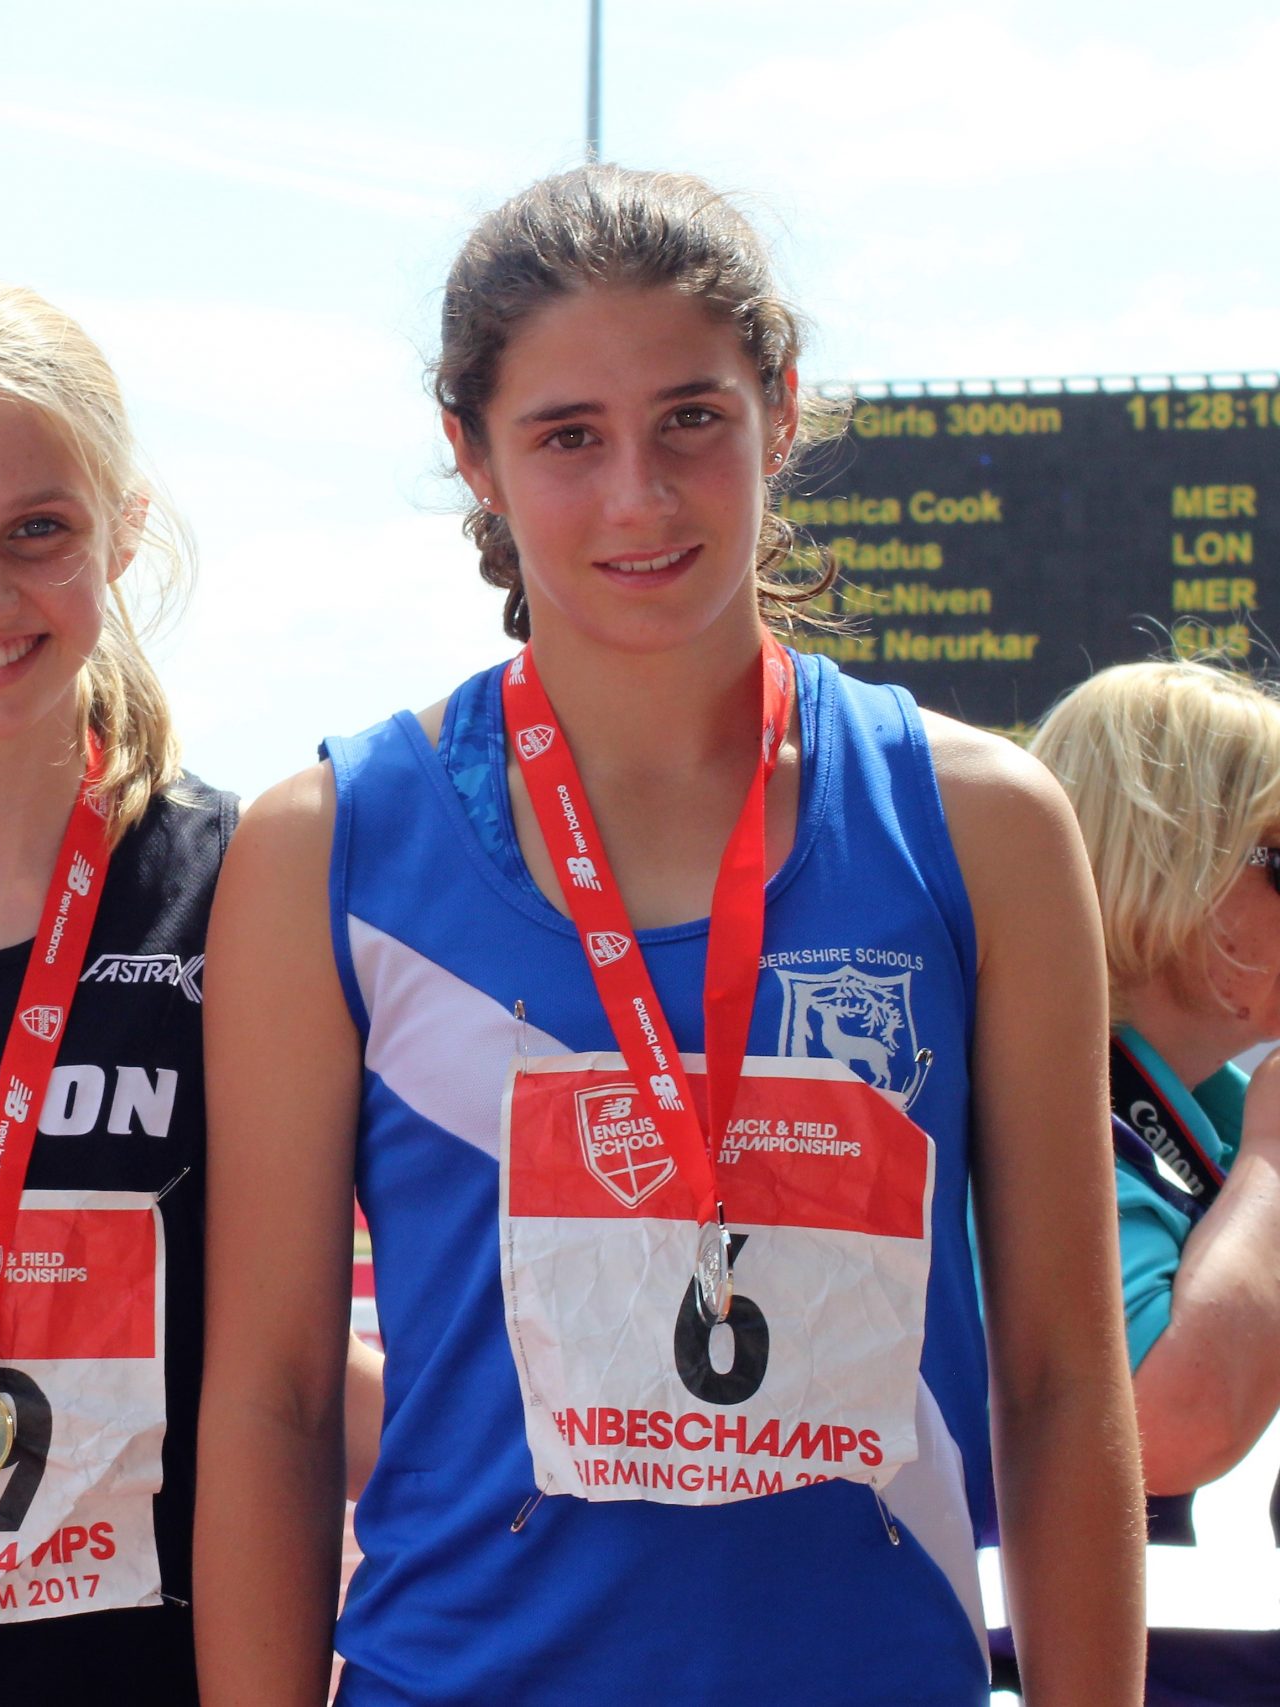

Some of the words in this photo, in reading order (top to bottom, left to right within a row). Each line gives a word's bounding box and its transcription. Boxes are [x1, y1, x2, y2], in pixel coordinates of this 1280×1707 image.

[854, 404, 937, 438] Girls
[945, 403, 1062, 437] 3000m
[910, 489, 1003, 524] Cook
[1172, 484, 1258, 519] MER
[831, 537, 944, 571] Radus
[1172, 531, 1254, 566] LON
[842, 583, 992, 617] McNiven
[1172, 577, 1258, 612] MER
[884, 628, 1040, 662] Nerurkar
[557, 784, 580, 831] balance
[572, 831, 588, 854] new
[59, 890, 72, 916] new
[45, 916, 69, 965] balance
[758, 948, 852, 970] BERKSHIRE
[855, 948, 925, 972] SCHOOLS
[632, 996, 659, 1045] balance
[651, 1045, 669, 1071] new
[592, 1116, 656, 1141] ENGLIS
[726, 1118, 772, 1135] ACK
[775, 1120, 789, 1136] &
[793, 1121, 838, 1140] FIELD
[722, 1134, 862, 1158] HAMPIONSHIPS
[1129, 1100, 1205, 1197] Canon
[4, 1267, 88, 1284] IONSHIPS
[21, 1251, 65, 1267] FIELD
[674, 1233, 770, 1406] 6
[552, 1407, 883, 1467] #NBESCHAMPS
[27, 1573, 102, 1607] 2017
